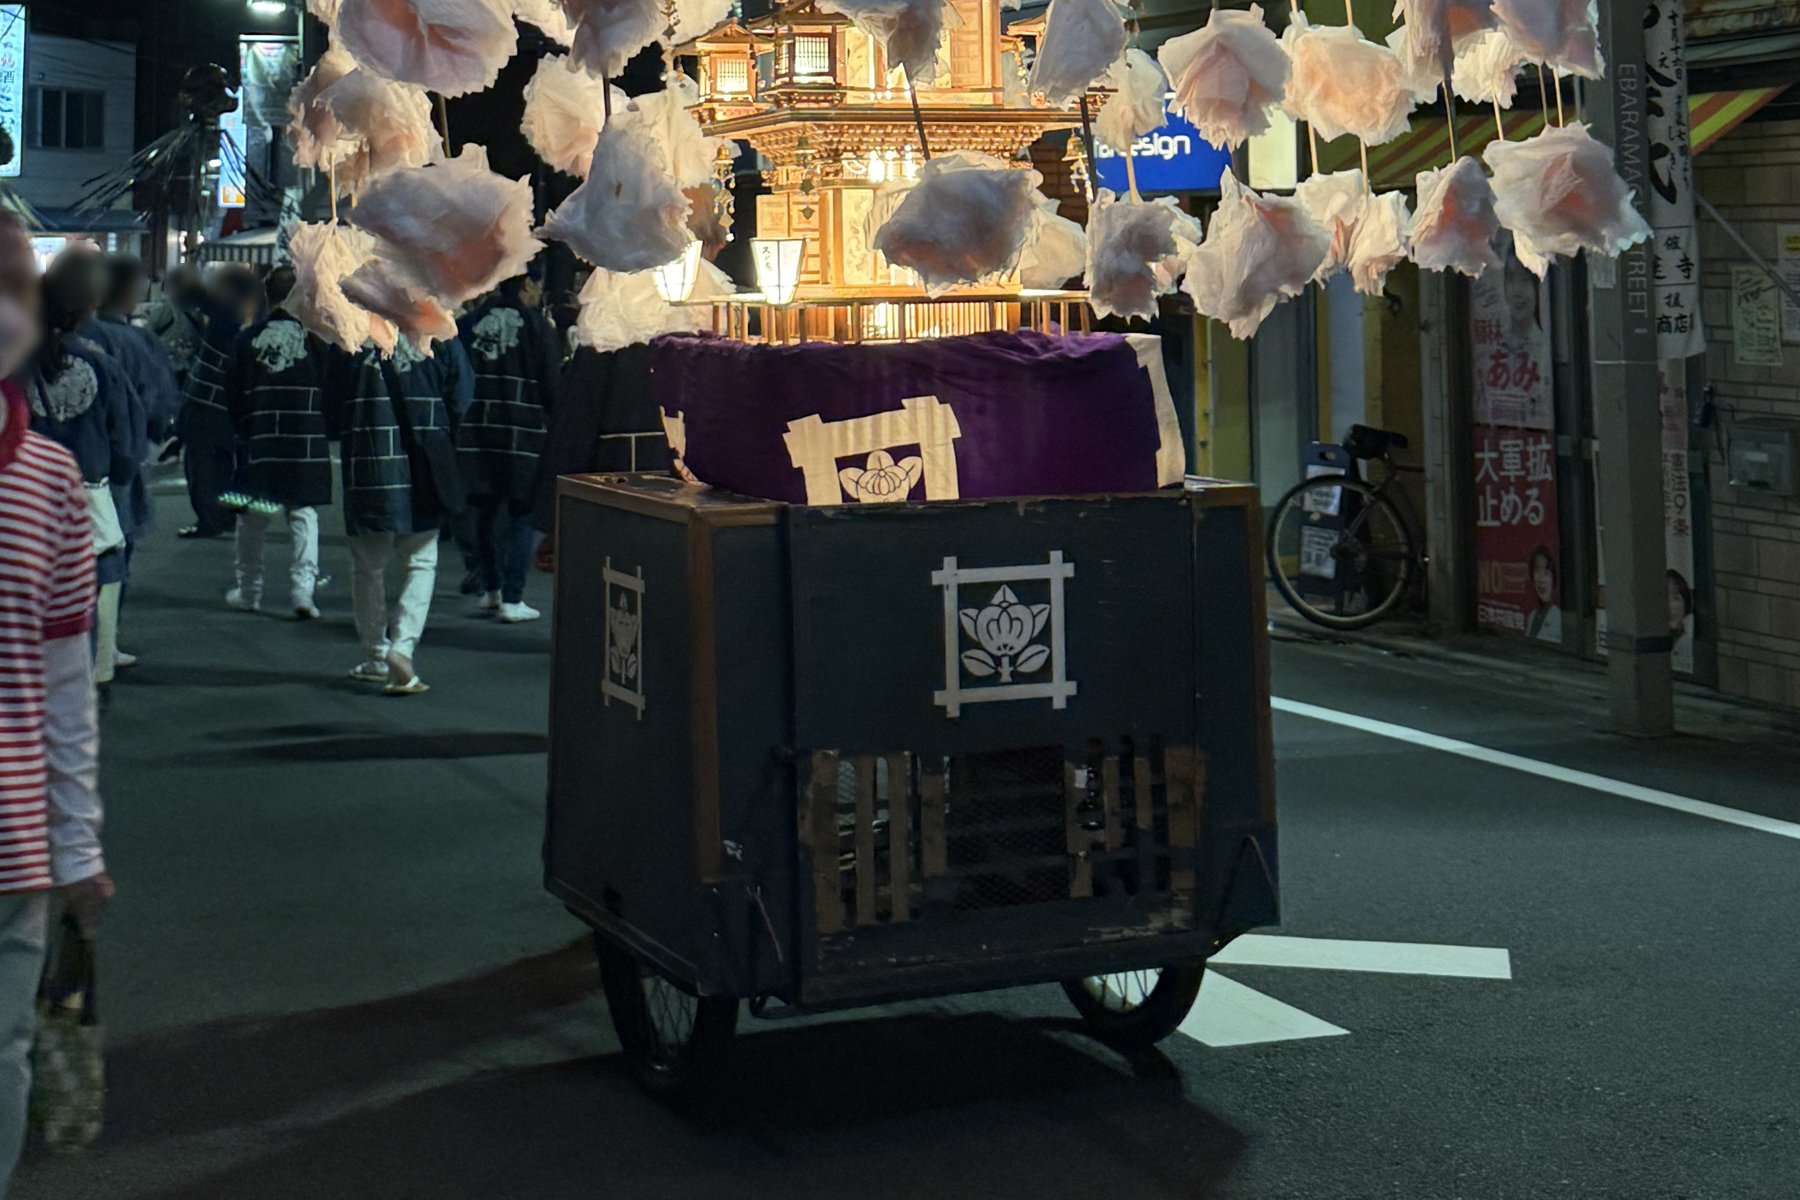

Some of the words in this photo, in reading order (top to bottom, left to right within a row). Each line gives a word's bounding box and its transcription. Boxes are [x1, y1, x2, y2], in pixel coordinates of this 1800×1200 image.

[1627, 247, 1648, 318] TREET
[1487, 350, 1541, 391] あみ
[1475, 438, 1553, 483] 大軍拡
[1476, 487, 1545, 527] 止める
